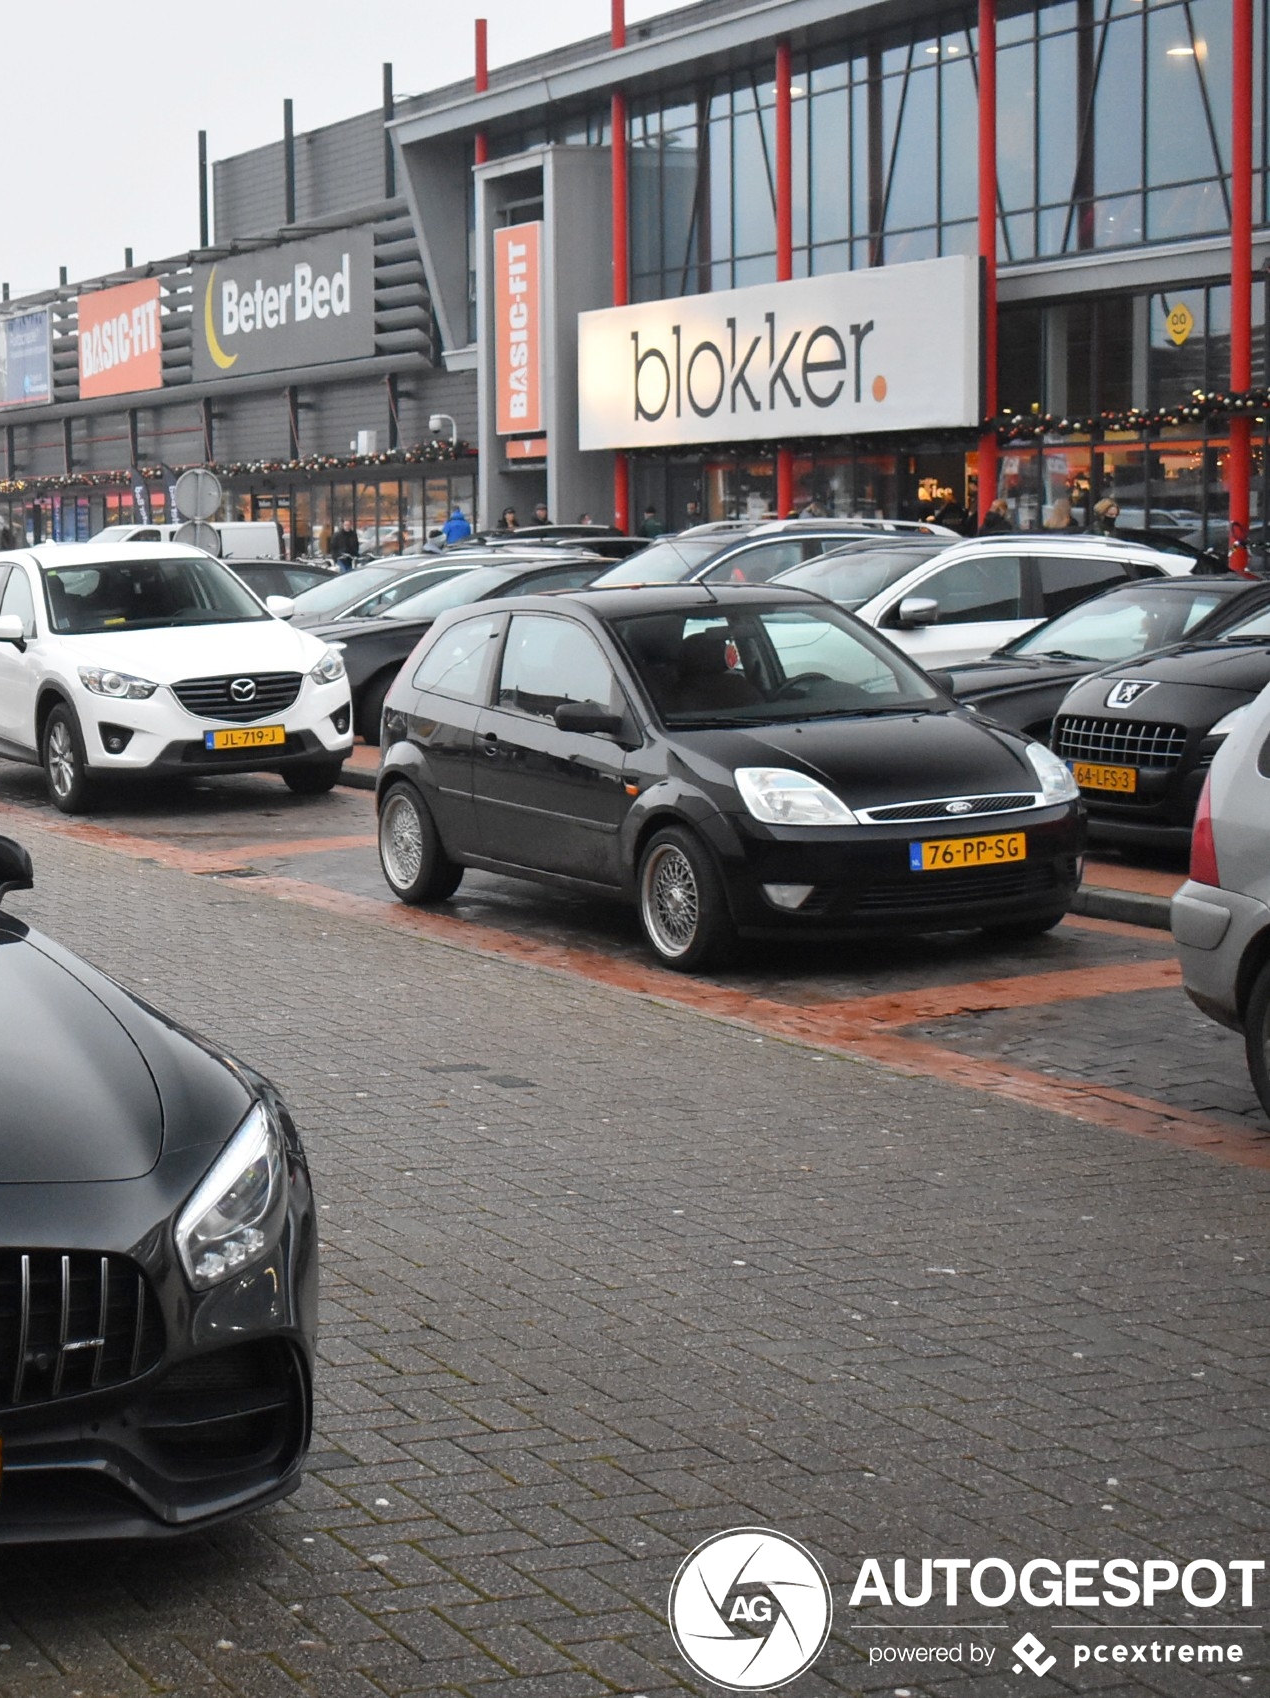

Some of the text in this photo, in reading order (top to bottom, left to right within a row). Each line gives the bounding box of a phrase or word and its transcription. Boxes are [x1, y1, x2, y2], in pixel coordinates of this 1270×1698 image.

[222, 253, 350, 337] Beter Bed
[81, 298, 158, 379] BASIC-FIT
[508, 240, 528, 419] BASIC-FIT
[222, 729, 275, 746] JL-719-J
[1077, 766, 1129, 788] 64-LFS-3
[929, 837, 1019, 865] 76-PP-SG
